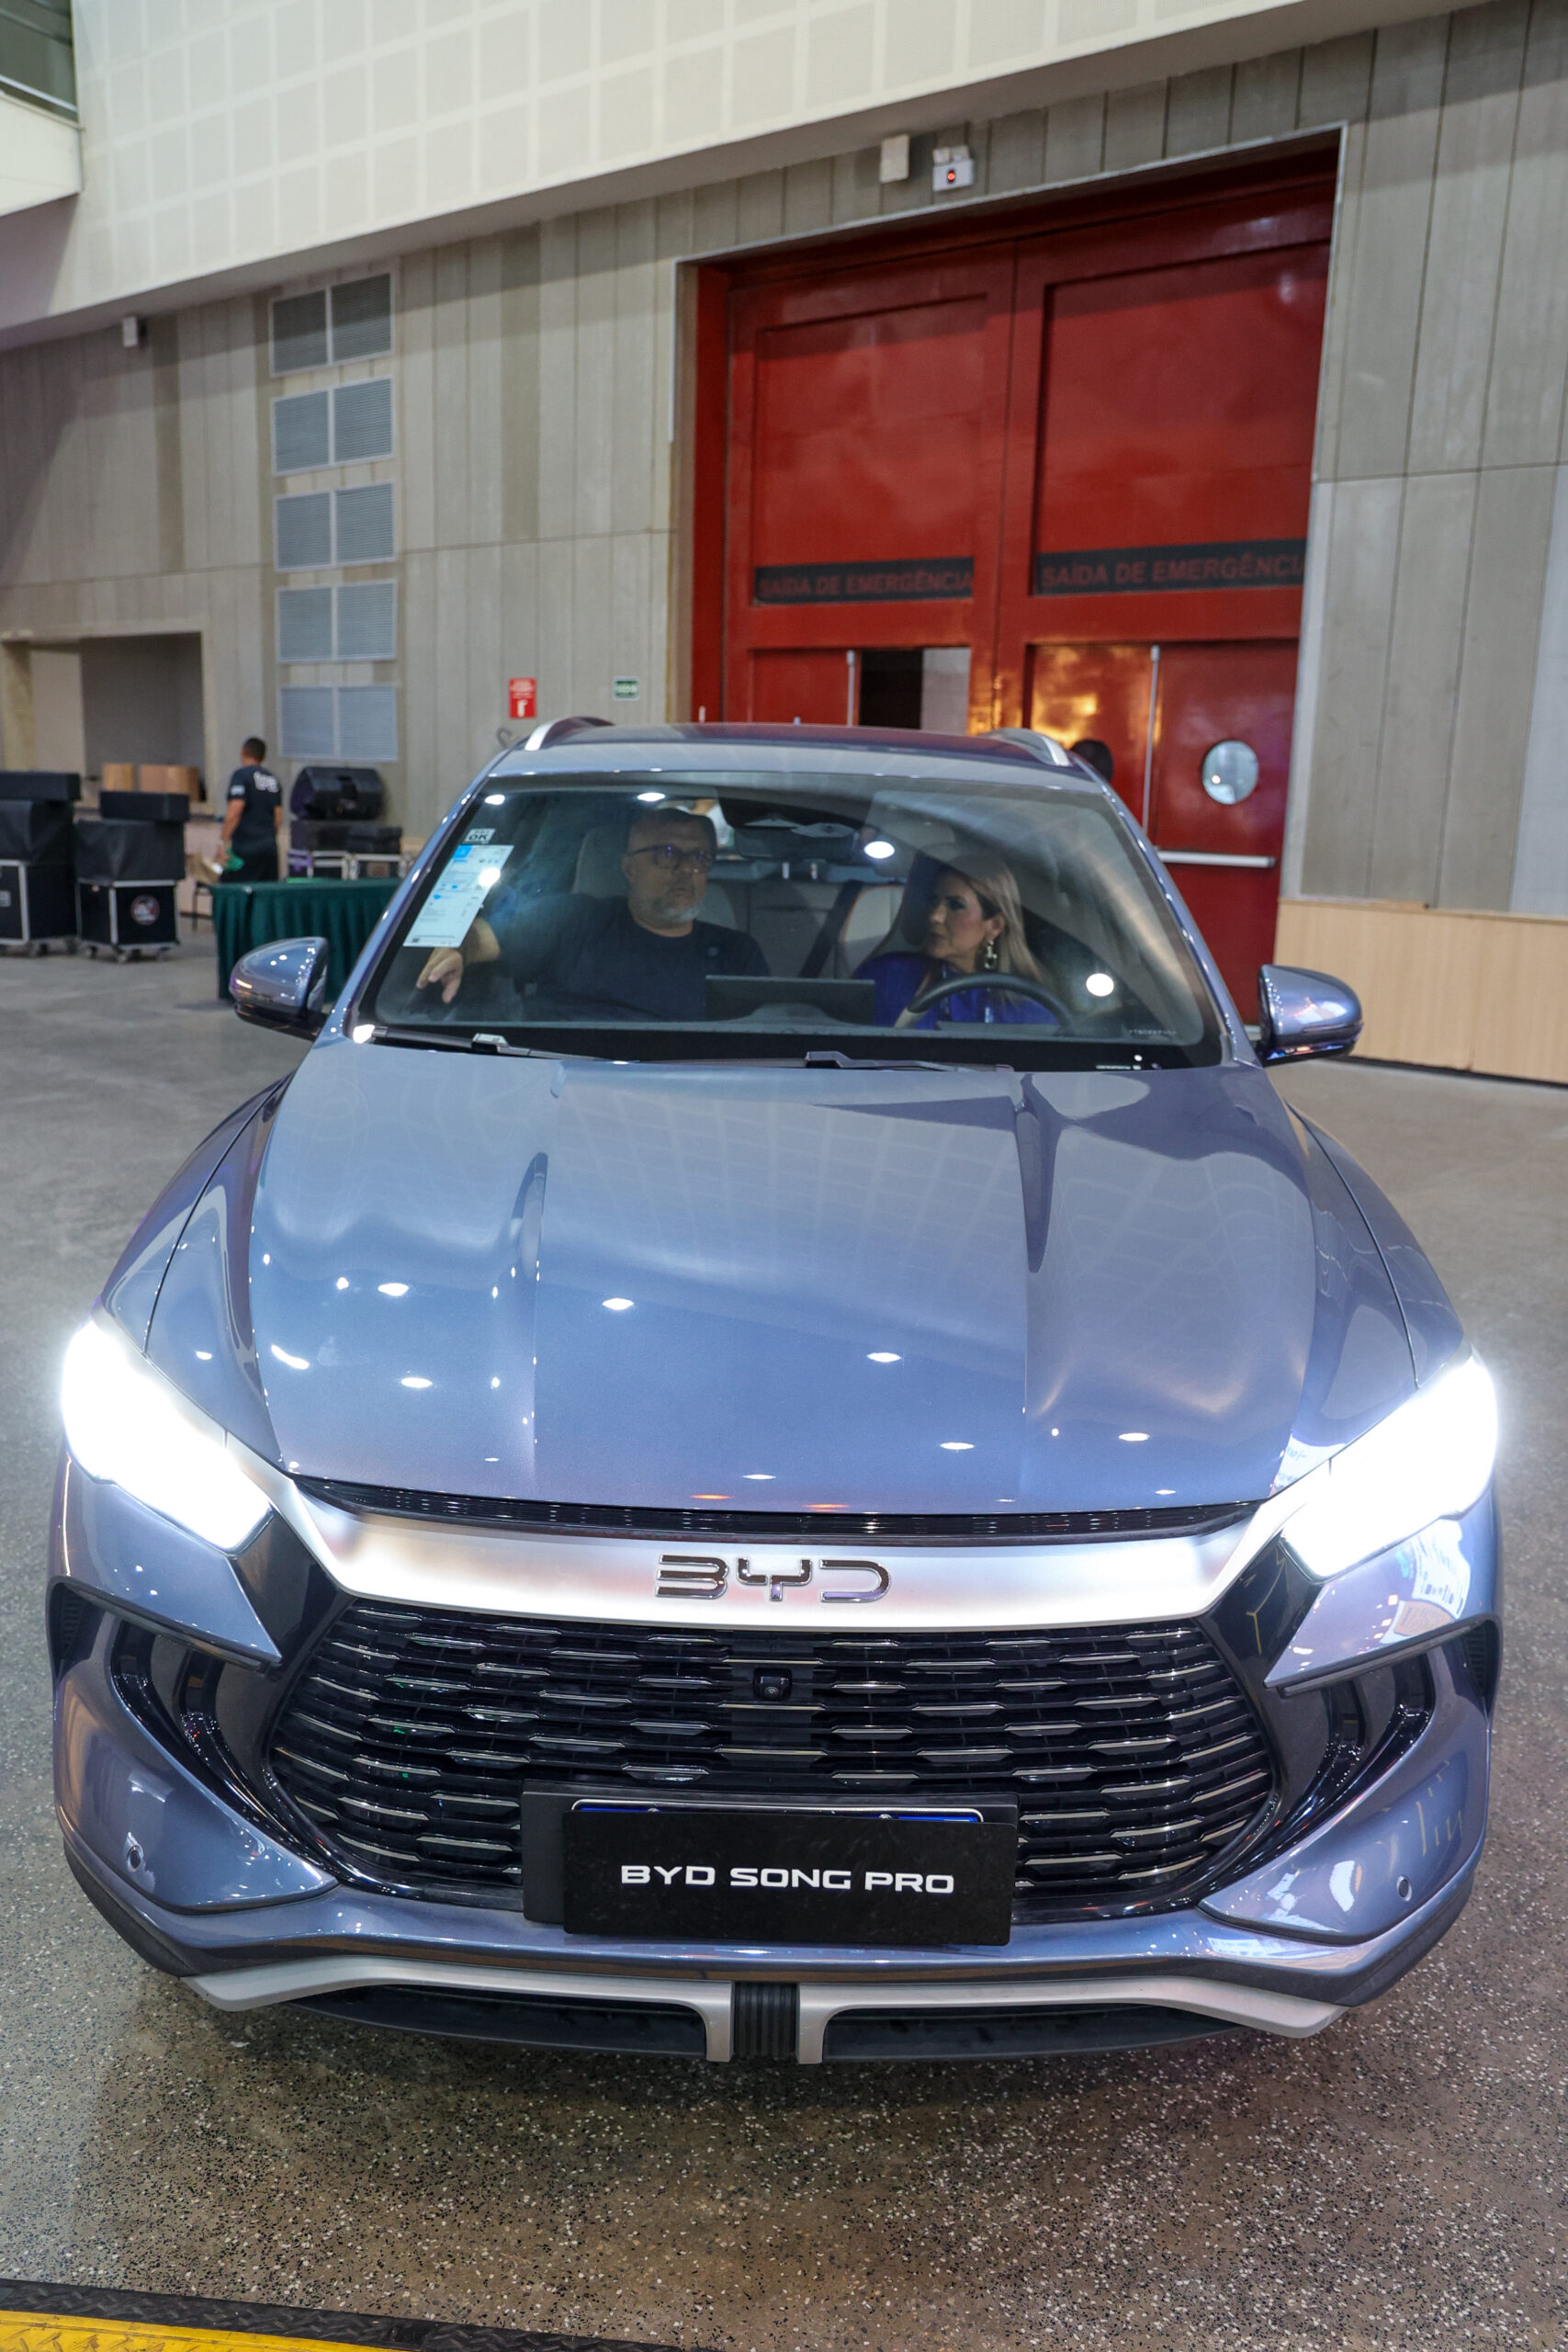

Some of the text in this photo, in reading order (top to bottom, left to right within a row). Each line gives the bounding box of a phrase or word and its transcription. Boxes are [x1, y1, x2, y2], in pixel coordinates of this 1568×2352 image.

[816, 574, 840, 595] DE
[1041, 560, 1109, 587] SAÍDA
[1115, 561, 1145, 584] DE
[655, 1555, 891, 1602] BYD
[621, 1865, 954, 1894] BYD SONG PRO
